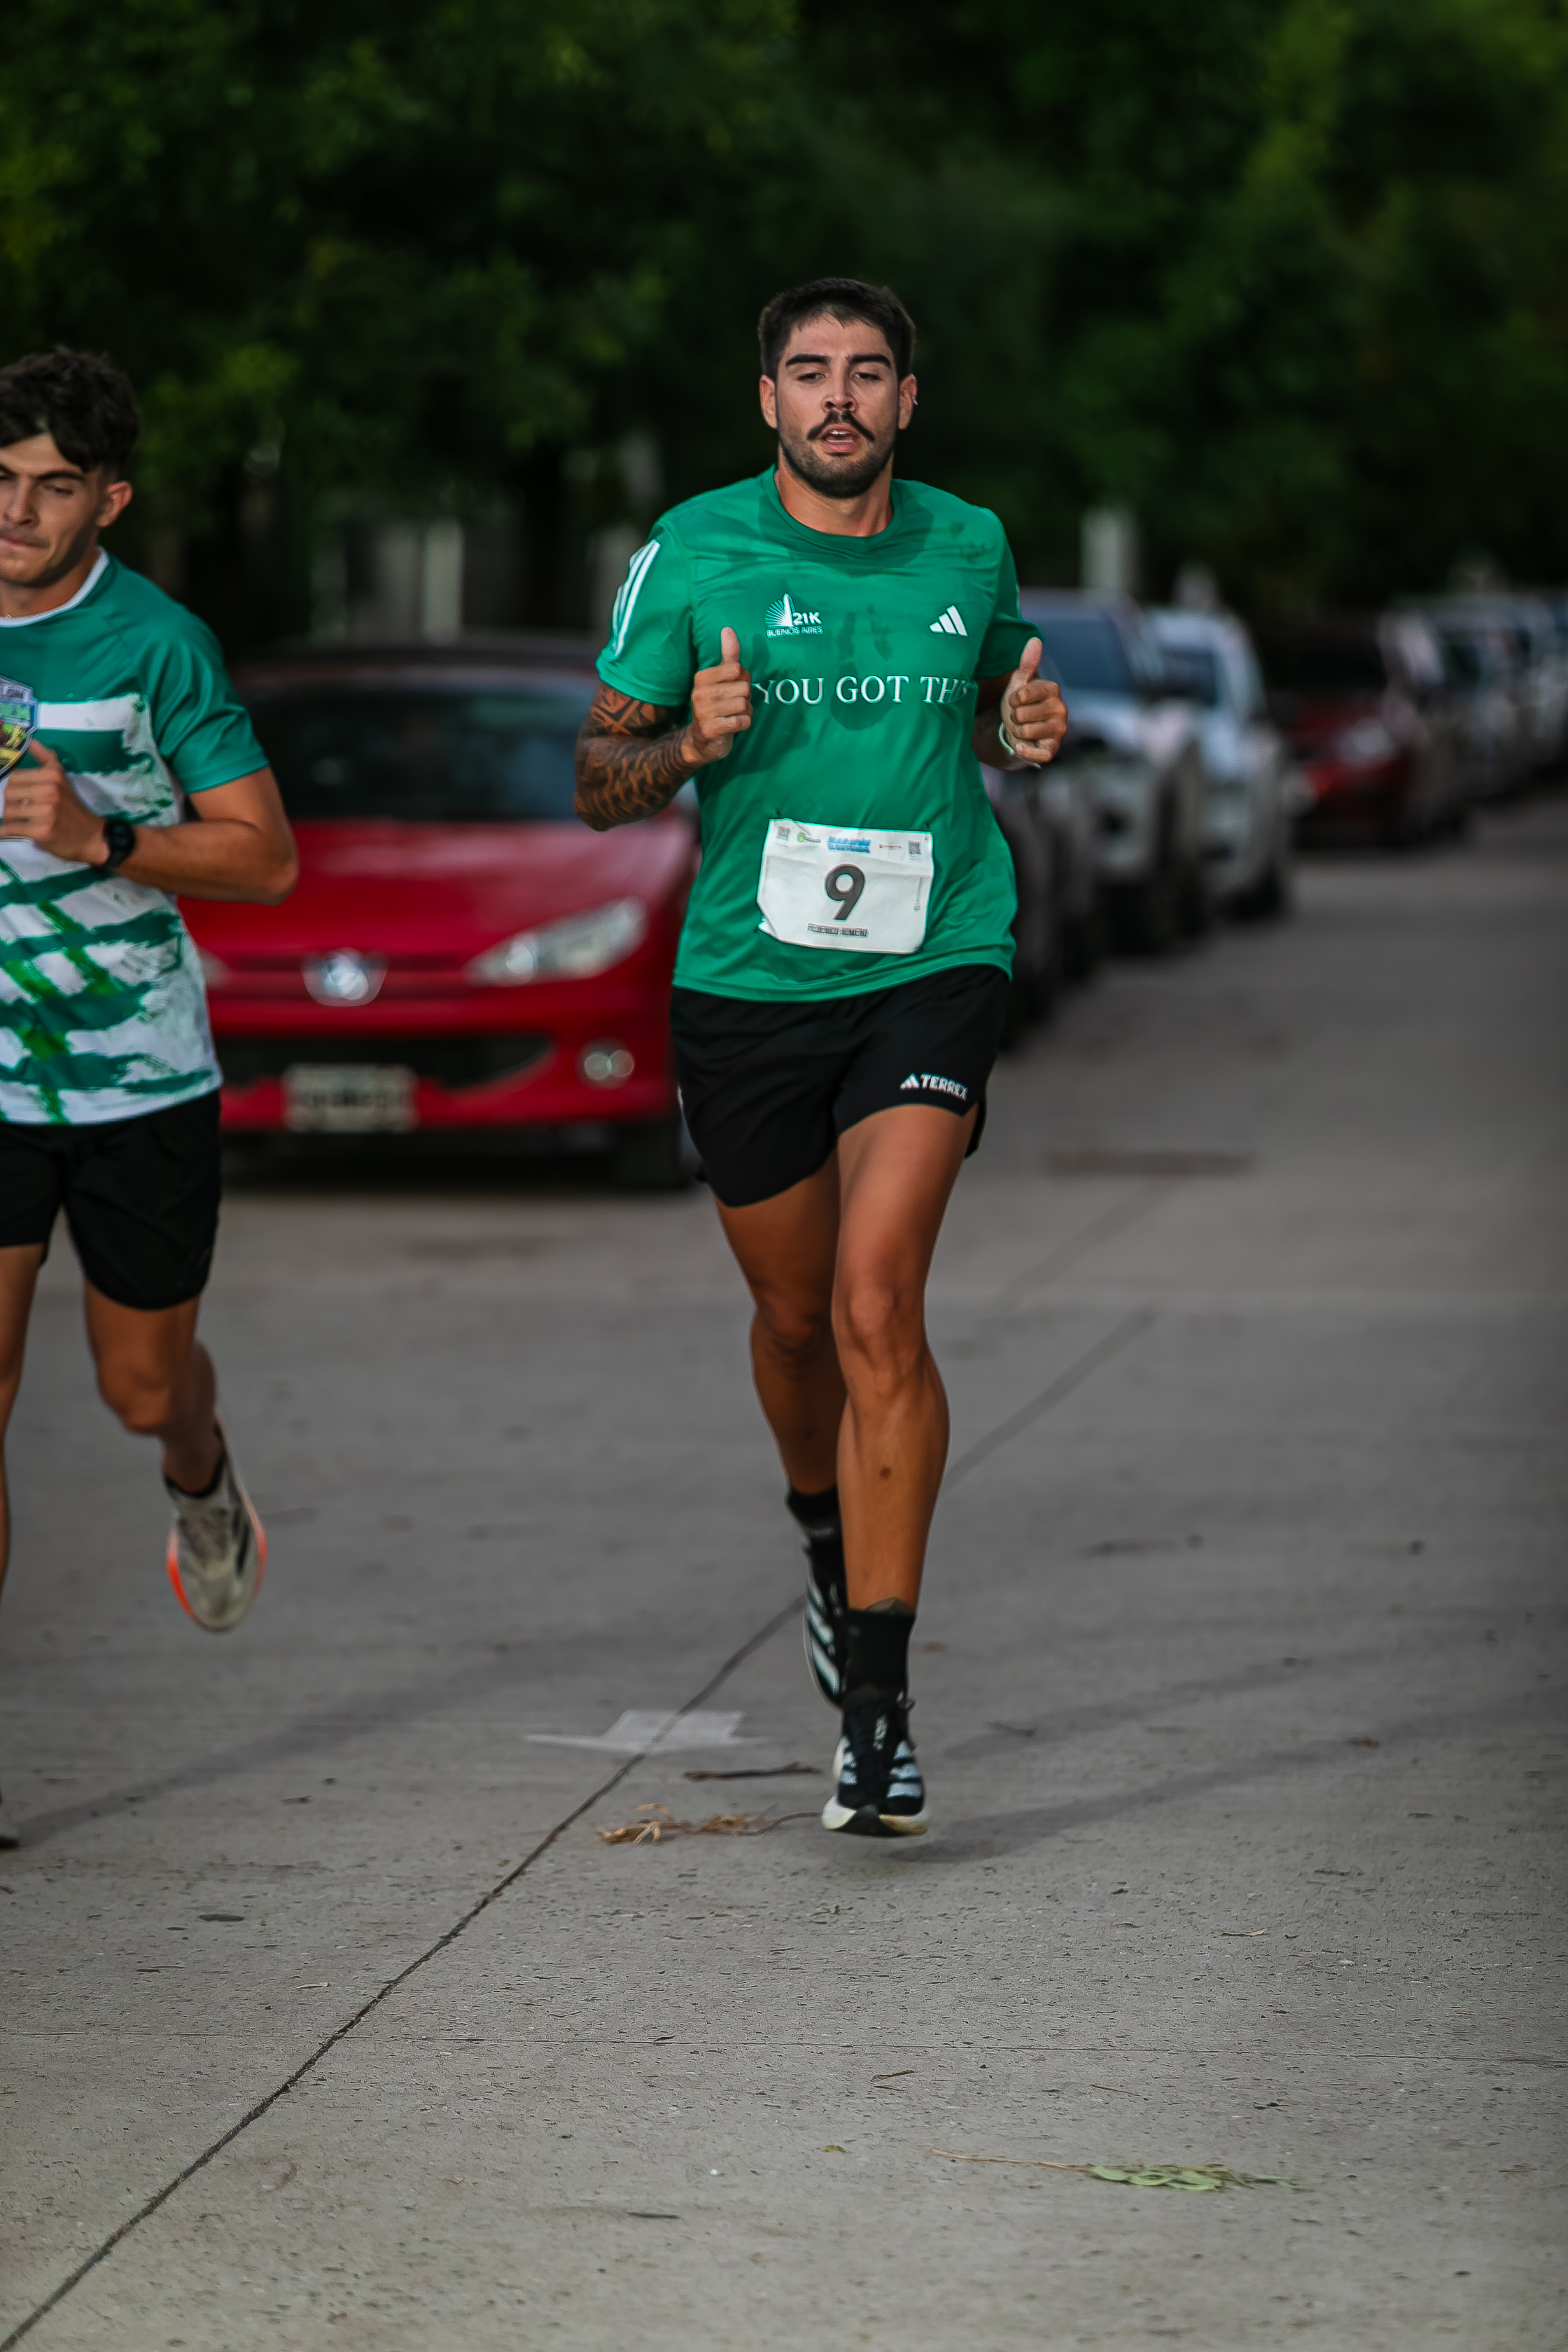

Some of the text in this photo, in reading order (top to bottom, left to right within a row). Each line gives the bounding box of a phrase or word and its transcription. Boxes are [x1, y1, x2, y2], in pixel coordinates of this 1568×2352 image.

[766, 626, 823, 638] BUENOS AIRES
[792, 611, 822, 626] 21K
[750, 677, 825, 705] YOU
[836, 676, 909, 704] GOT
[825, 862, 866, 920] 9
[920, 1073, 968, 1101] TERREX
